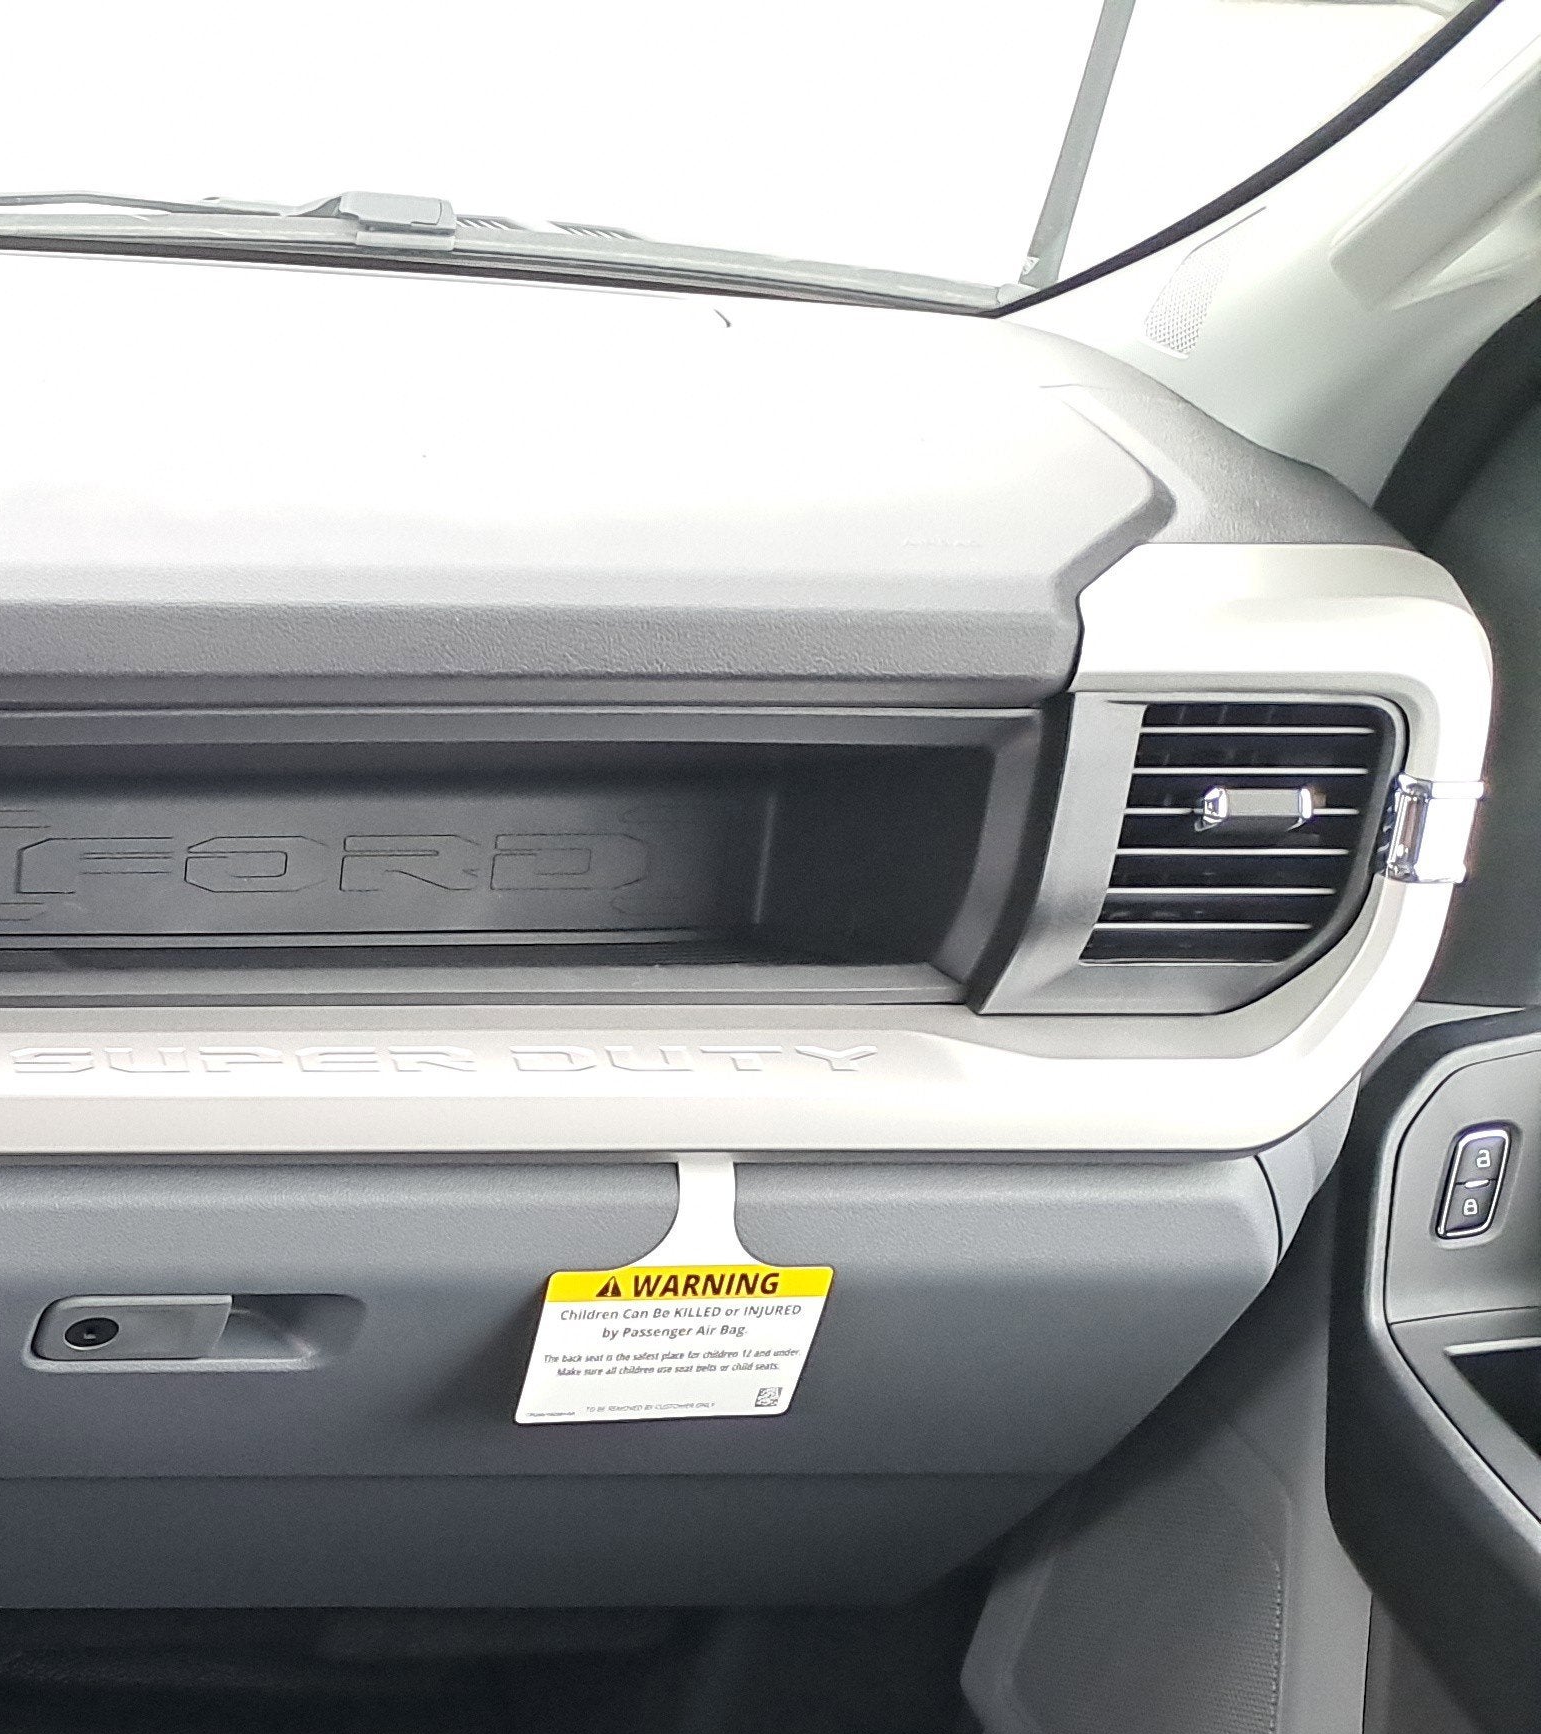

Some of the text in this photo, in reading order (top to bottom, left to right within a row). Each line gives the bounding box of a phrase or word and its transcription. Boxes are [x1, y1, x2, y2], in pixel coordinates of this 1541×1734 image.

[17, 832, 649, 893] FORD
[9, 1045, 877, 1077] SUPER DUTY
[633, 1272, 780, 1298] WARNING
[560, 1304, 802, 1321] Children Can Be KILLED or INJURED
[602, 1327, 619, 1340] by
[622, 1326, 693, 1339] Passenger
[696, 1325, 717, 1335] Air
[544, 1354, 560, 1364] The
[562, 1353, 583, 1363] back
[585, 1354, 604, 1362] seat
[615, 1352, 631, 1361] the
[633, 1352, 660, 1361] safest
[661, 1350, 685, 1361] place
[702, 1350, 739, 1359] children
[753, 1349, 772, 1358] and
[557, 1367, 582, 1376] Make
[584, 1367, 604, 1375] sure
[619, 1365, 655, 1374] children
[657, 1366, 673, 1374] use
[675, 1365, 694, 1373] seat
[696, 1363, 717, 1373] belts
[731, 1362, 754, 1372] child
